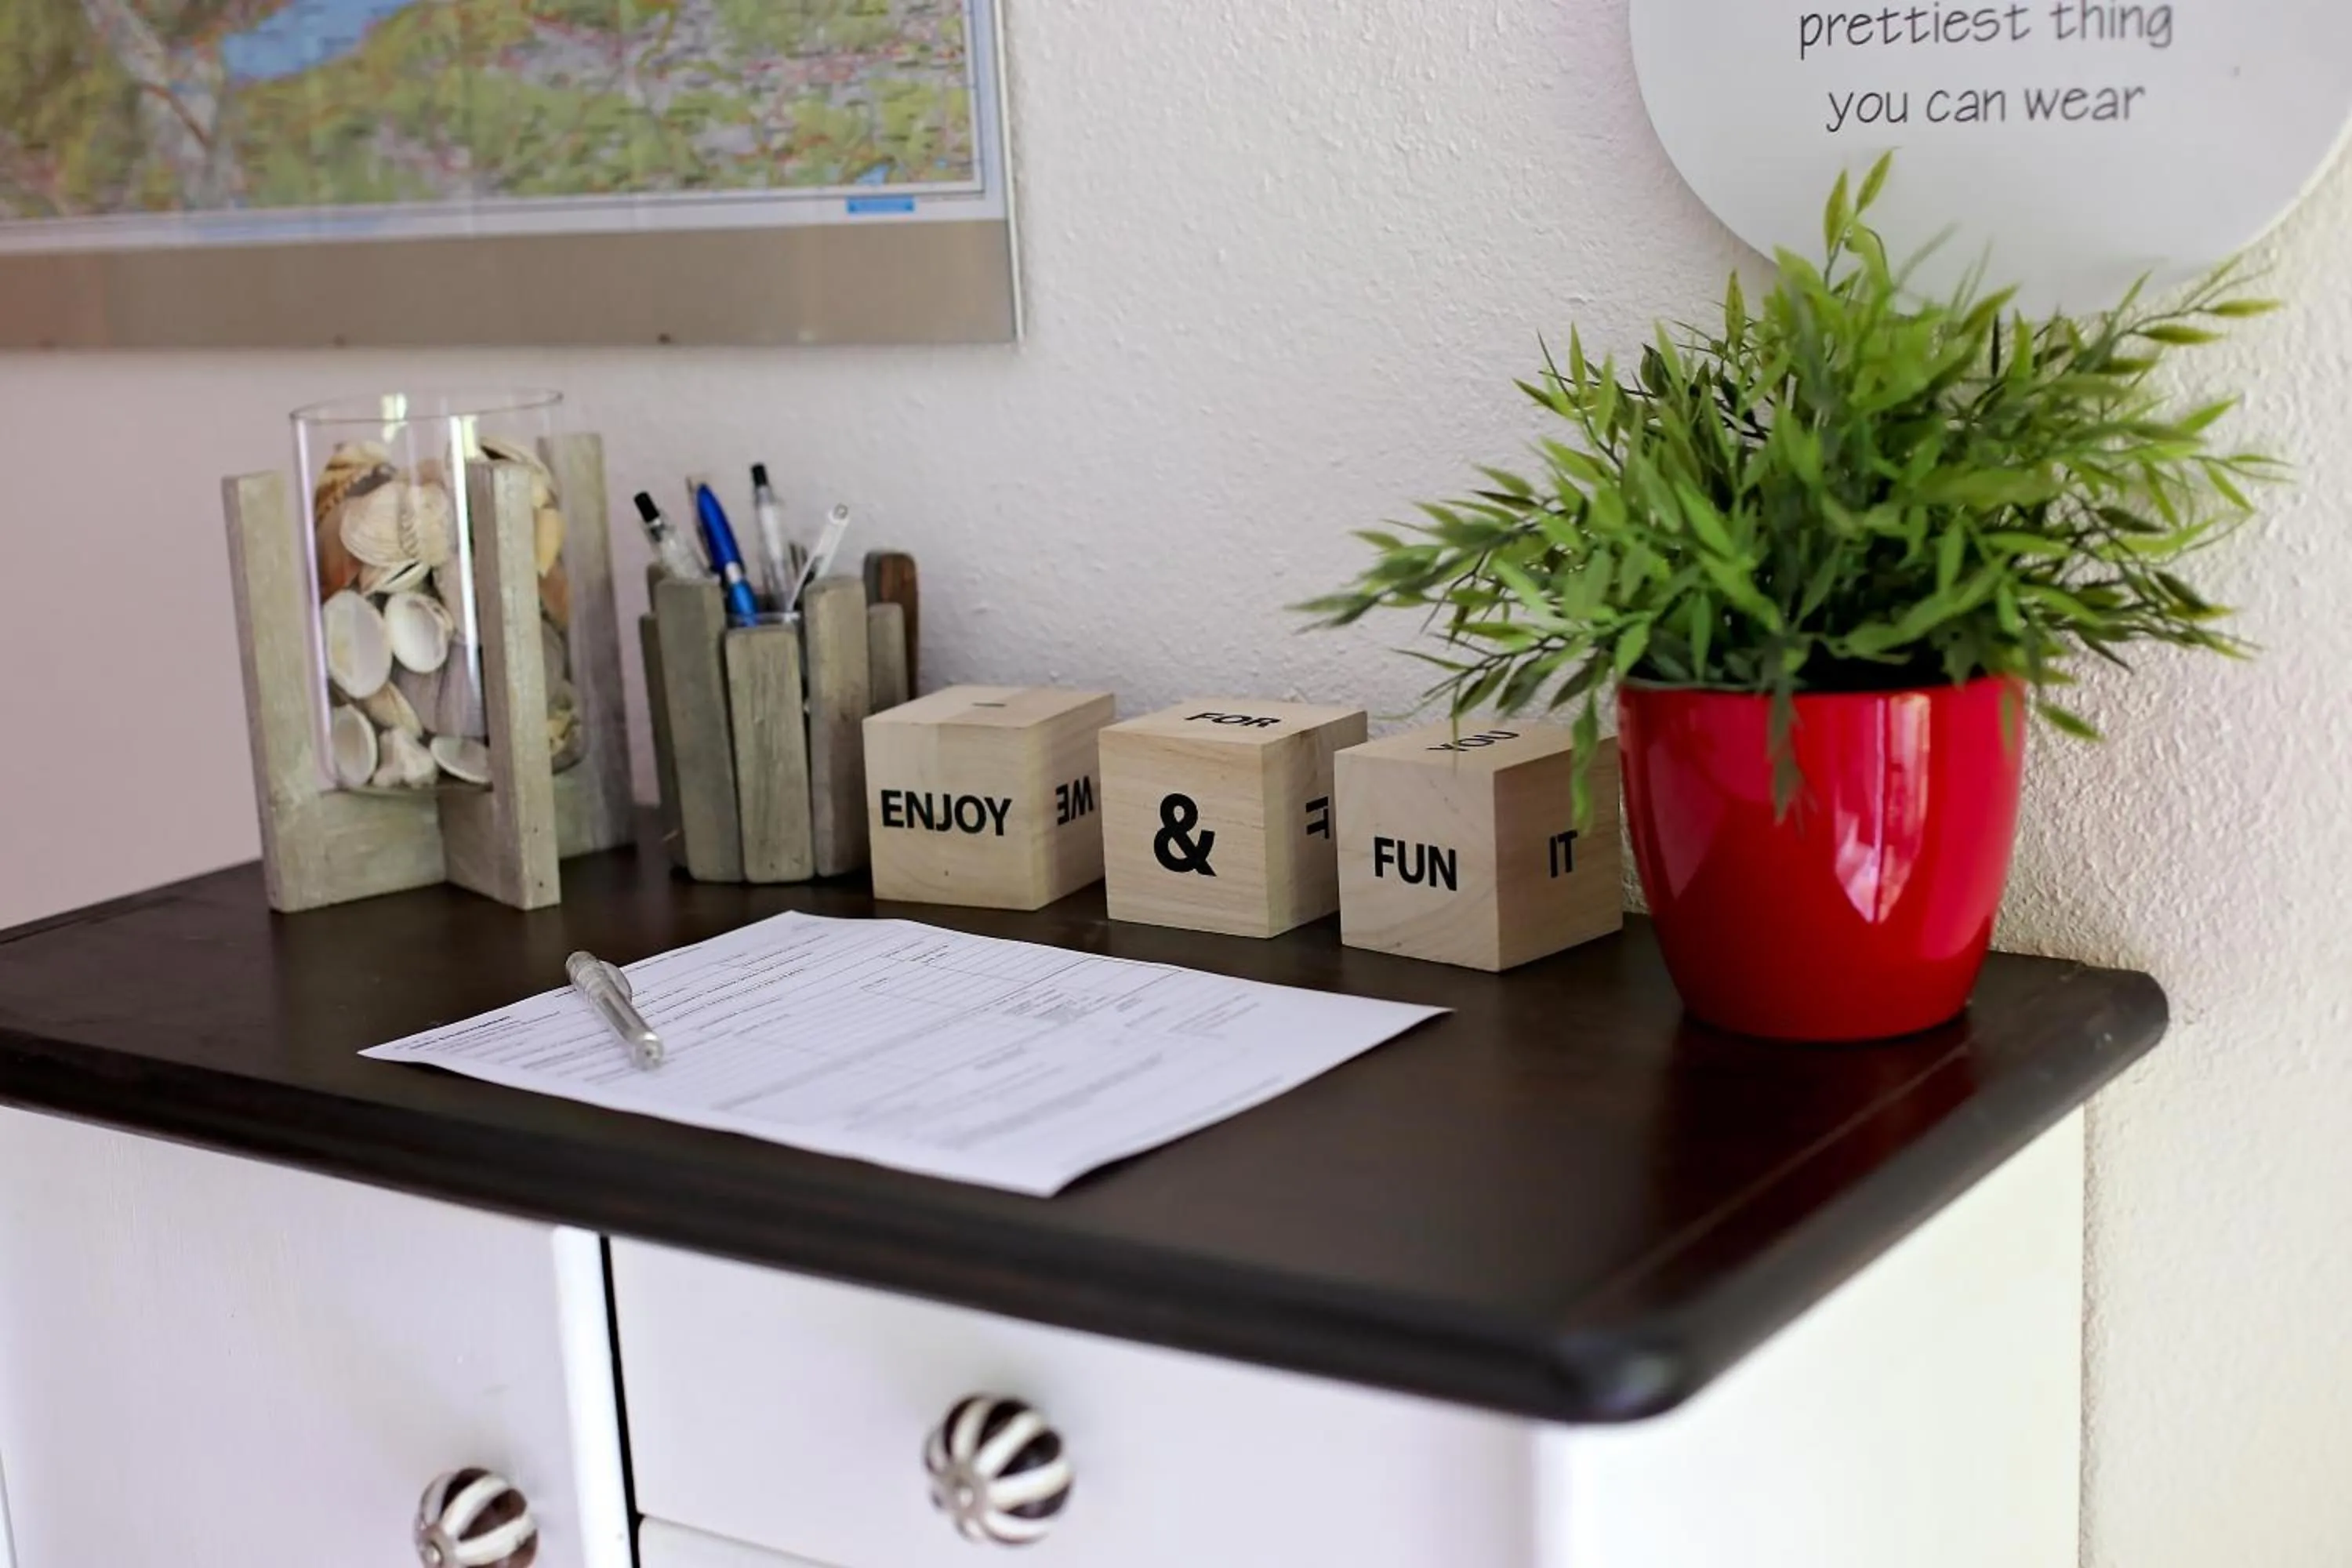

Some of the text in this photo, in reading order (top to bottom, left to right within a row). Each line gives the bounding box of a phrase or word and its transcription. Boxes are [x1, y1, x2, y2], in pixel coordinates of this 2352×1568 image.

[1800, 0, 2173, 60] prettiest thing
[1826, 85, 2147, 132] you can wear
[1185, 712, 1281, 728] FOR
[1426, 730, 1520, 752] YOU
[880, 789, 1013, 837] ENJOY
[1055, 775, 1094, 826] WE
[1153, 793, 1218, 877] &
[1549, 829, 1578, 878] IT
[1374, 837, 1457, 891] FUN
